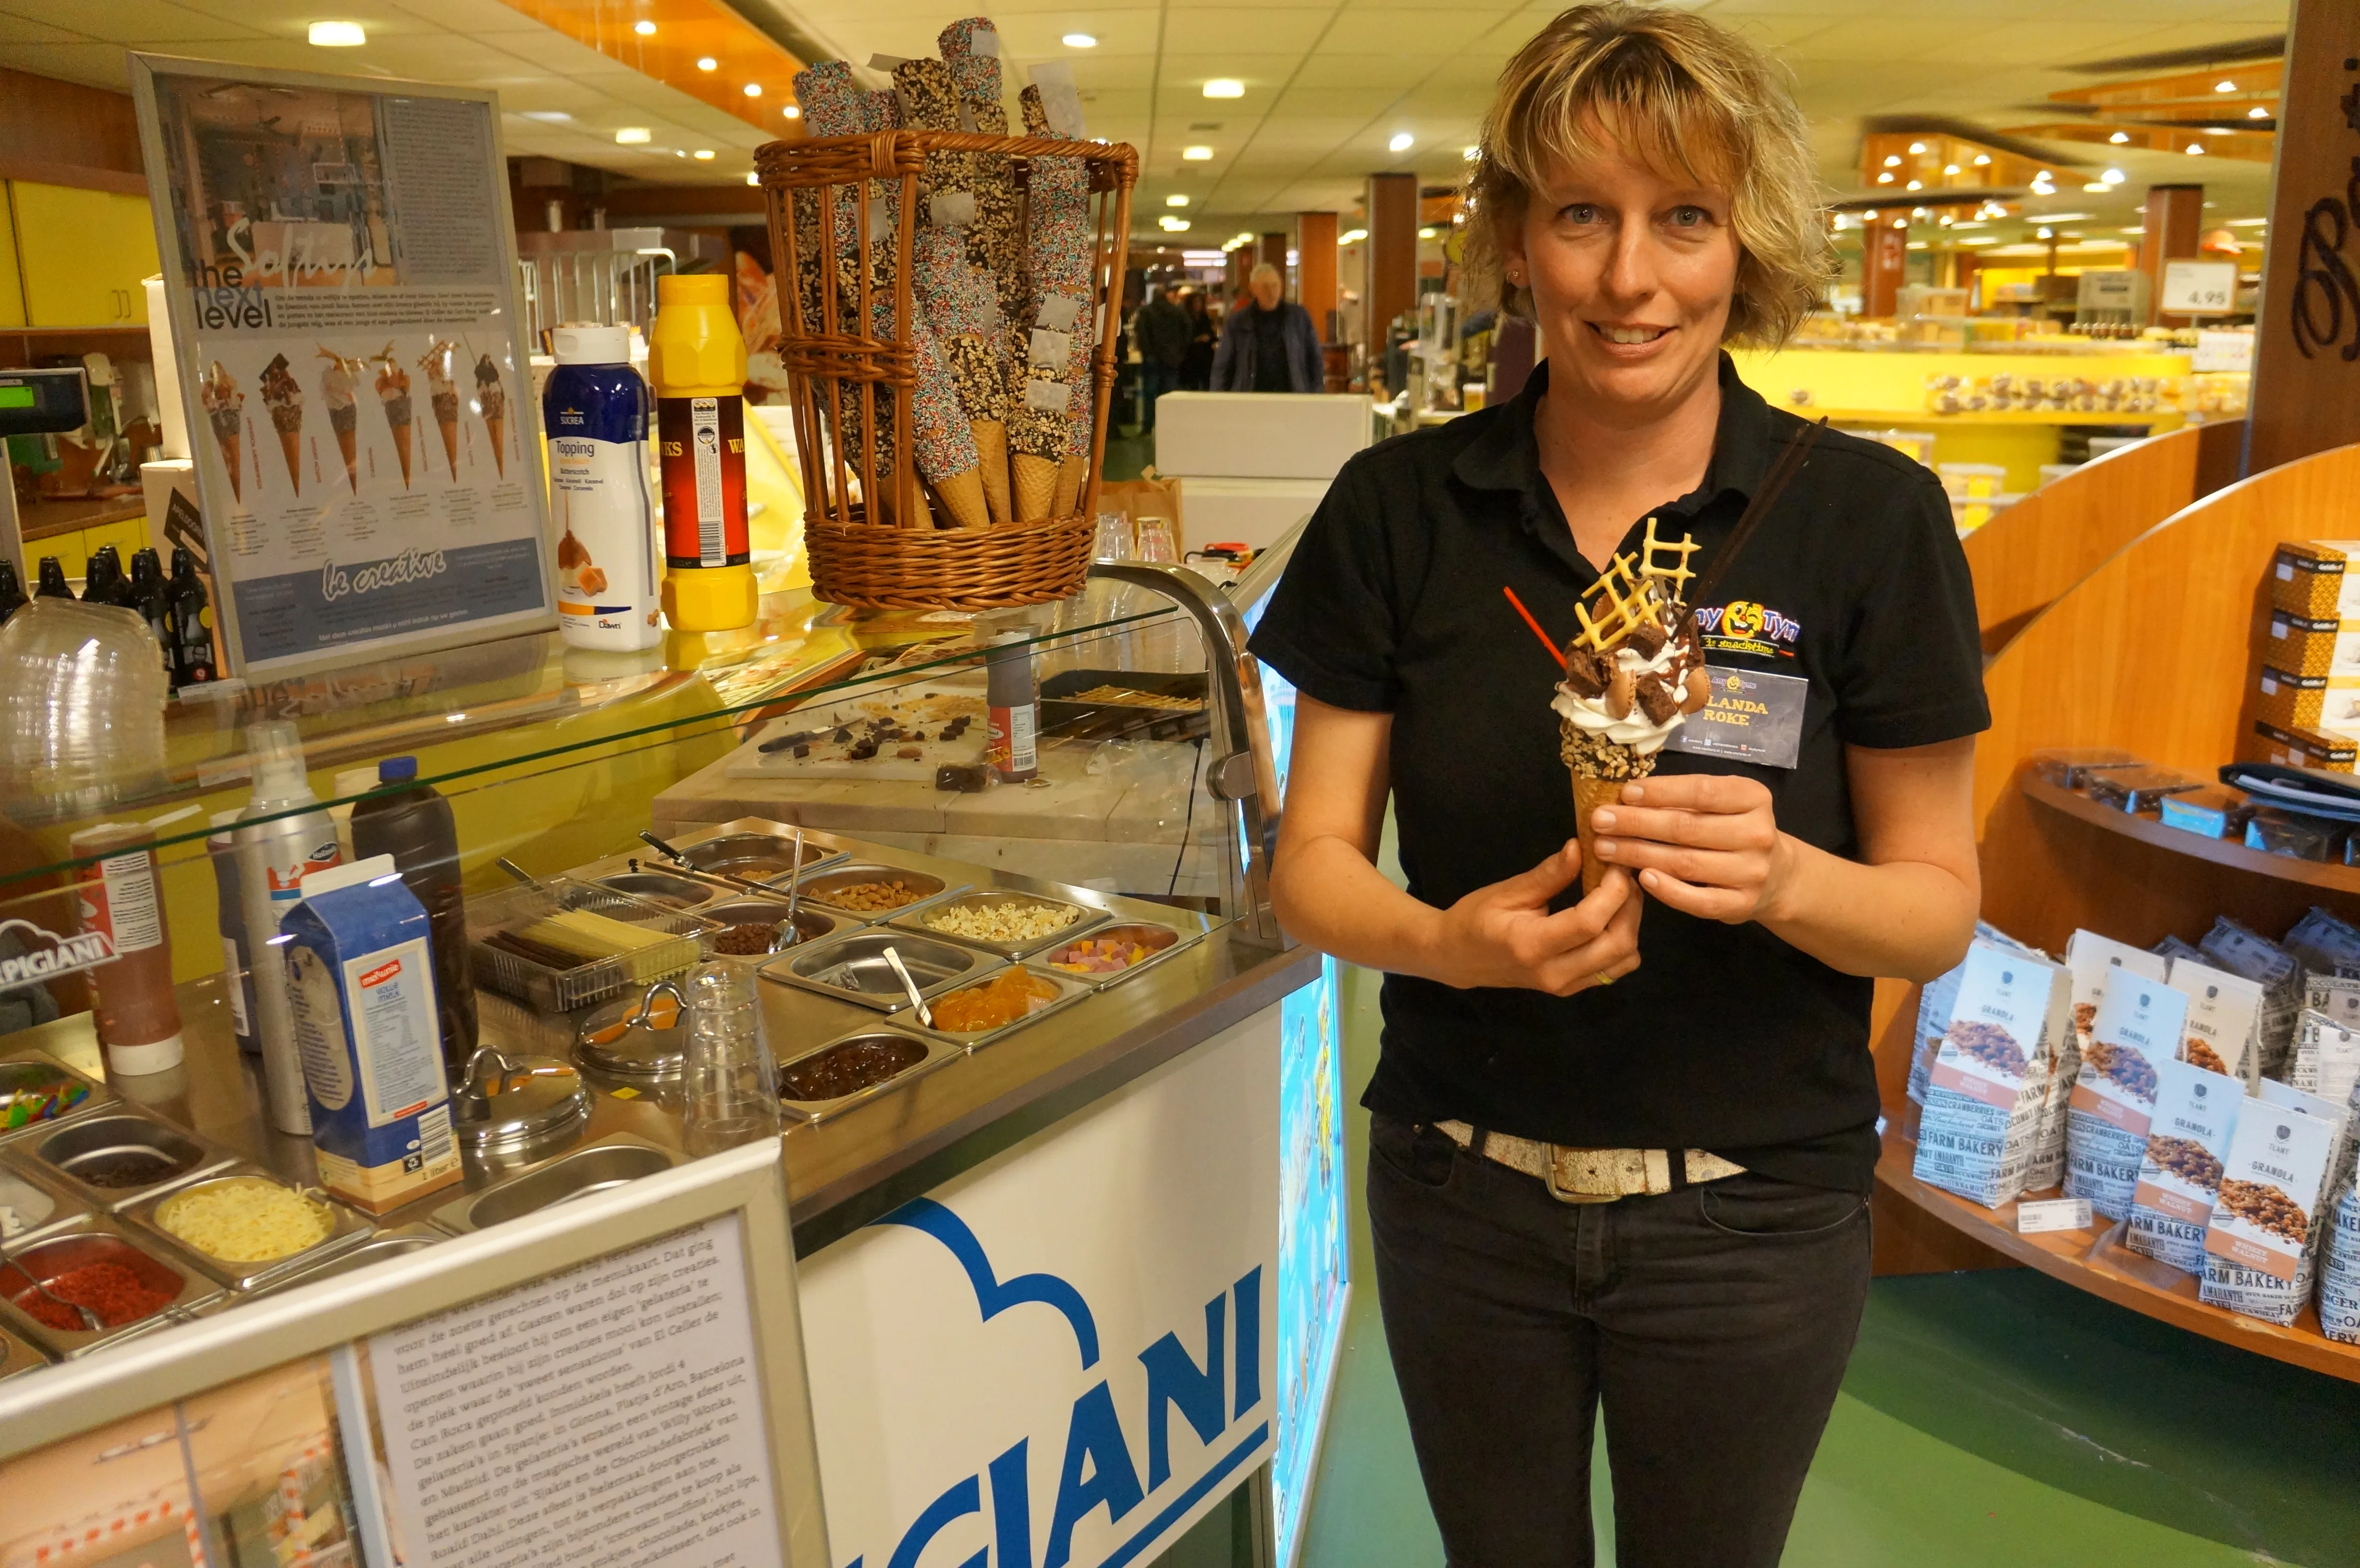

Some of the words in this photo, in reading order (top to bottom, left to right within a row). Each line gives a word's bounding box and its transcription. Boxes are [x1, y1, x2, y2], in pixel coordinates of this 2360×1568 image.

[191, 259, 243, 287] the
[193, 280, 264, 309] next
[2188, 291, 2226, 306] 4.95
[195, 298, 272, 330] level
[556, 440, 595, 457] Topping
[322, 560, 350, 601] be
[353, 548, 447, 594] creative
[599, 620, 621, 630] Dawn
[1695, 608, 1724, 632] ny
[1703, 709, 1750, 726] ROKE
[1981, 1003, 2015, 1022] GRANOLA
[2119, 1026, 2151, 1046] GRANOLA
[2190, 1019, 2217, 1037] RANOLA
[2174, 1117, 2212, 1138] GRANOLA
[1928, 1131, 1954, 1149] FARM
[1958, 1138, 2003, 1158] BAKERY
[429, 1162, 449, 1179] liter
[2251, 1160, 2294, 1183] GRANOLA
[2128, 1215, 2153, 1232] ARM
[2202, 1267, 2230, 1285] ARM
[2235, 1271, 2292, 1290] BAKERY
[400, 1359, 479, 1393] Uiteindelijk
[844, 1263, 1262, 1568] GIANI
